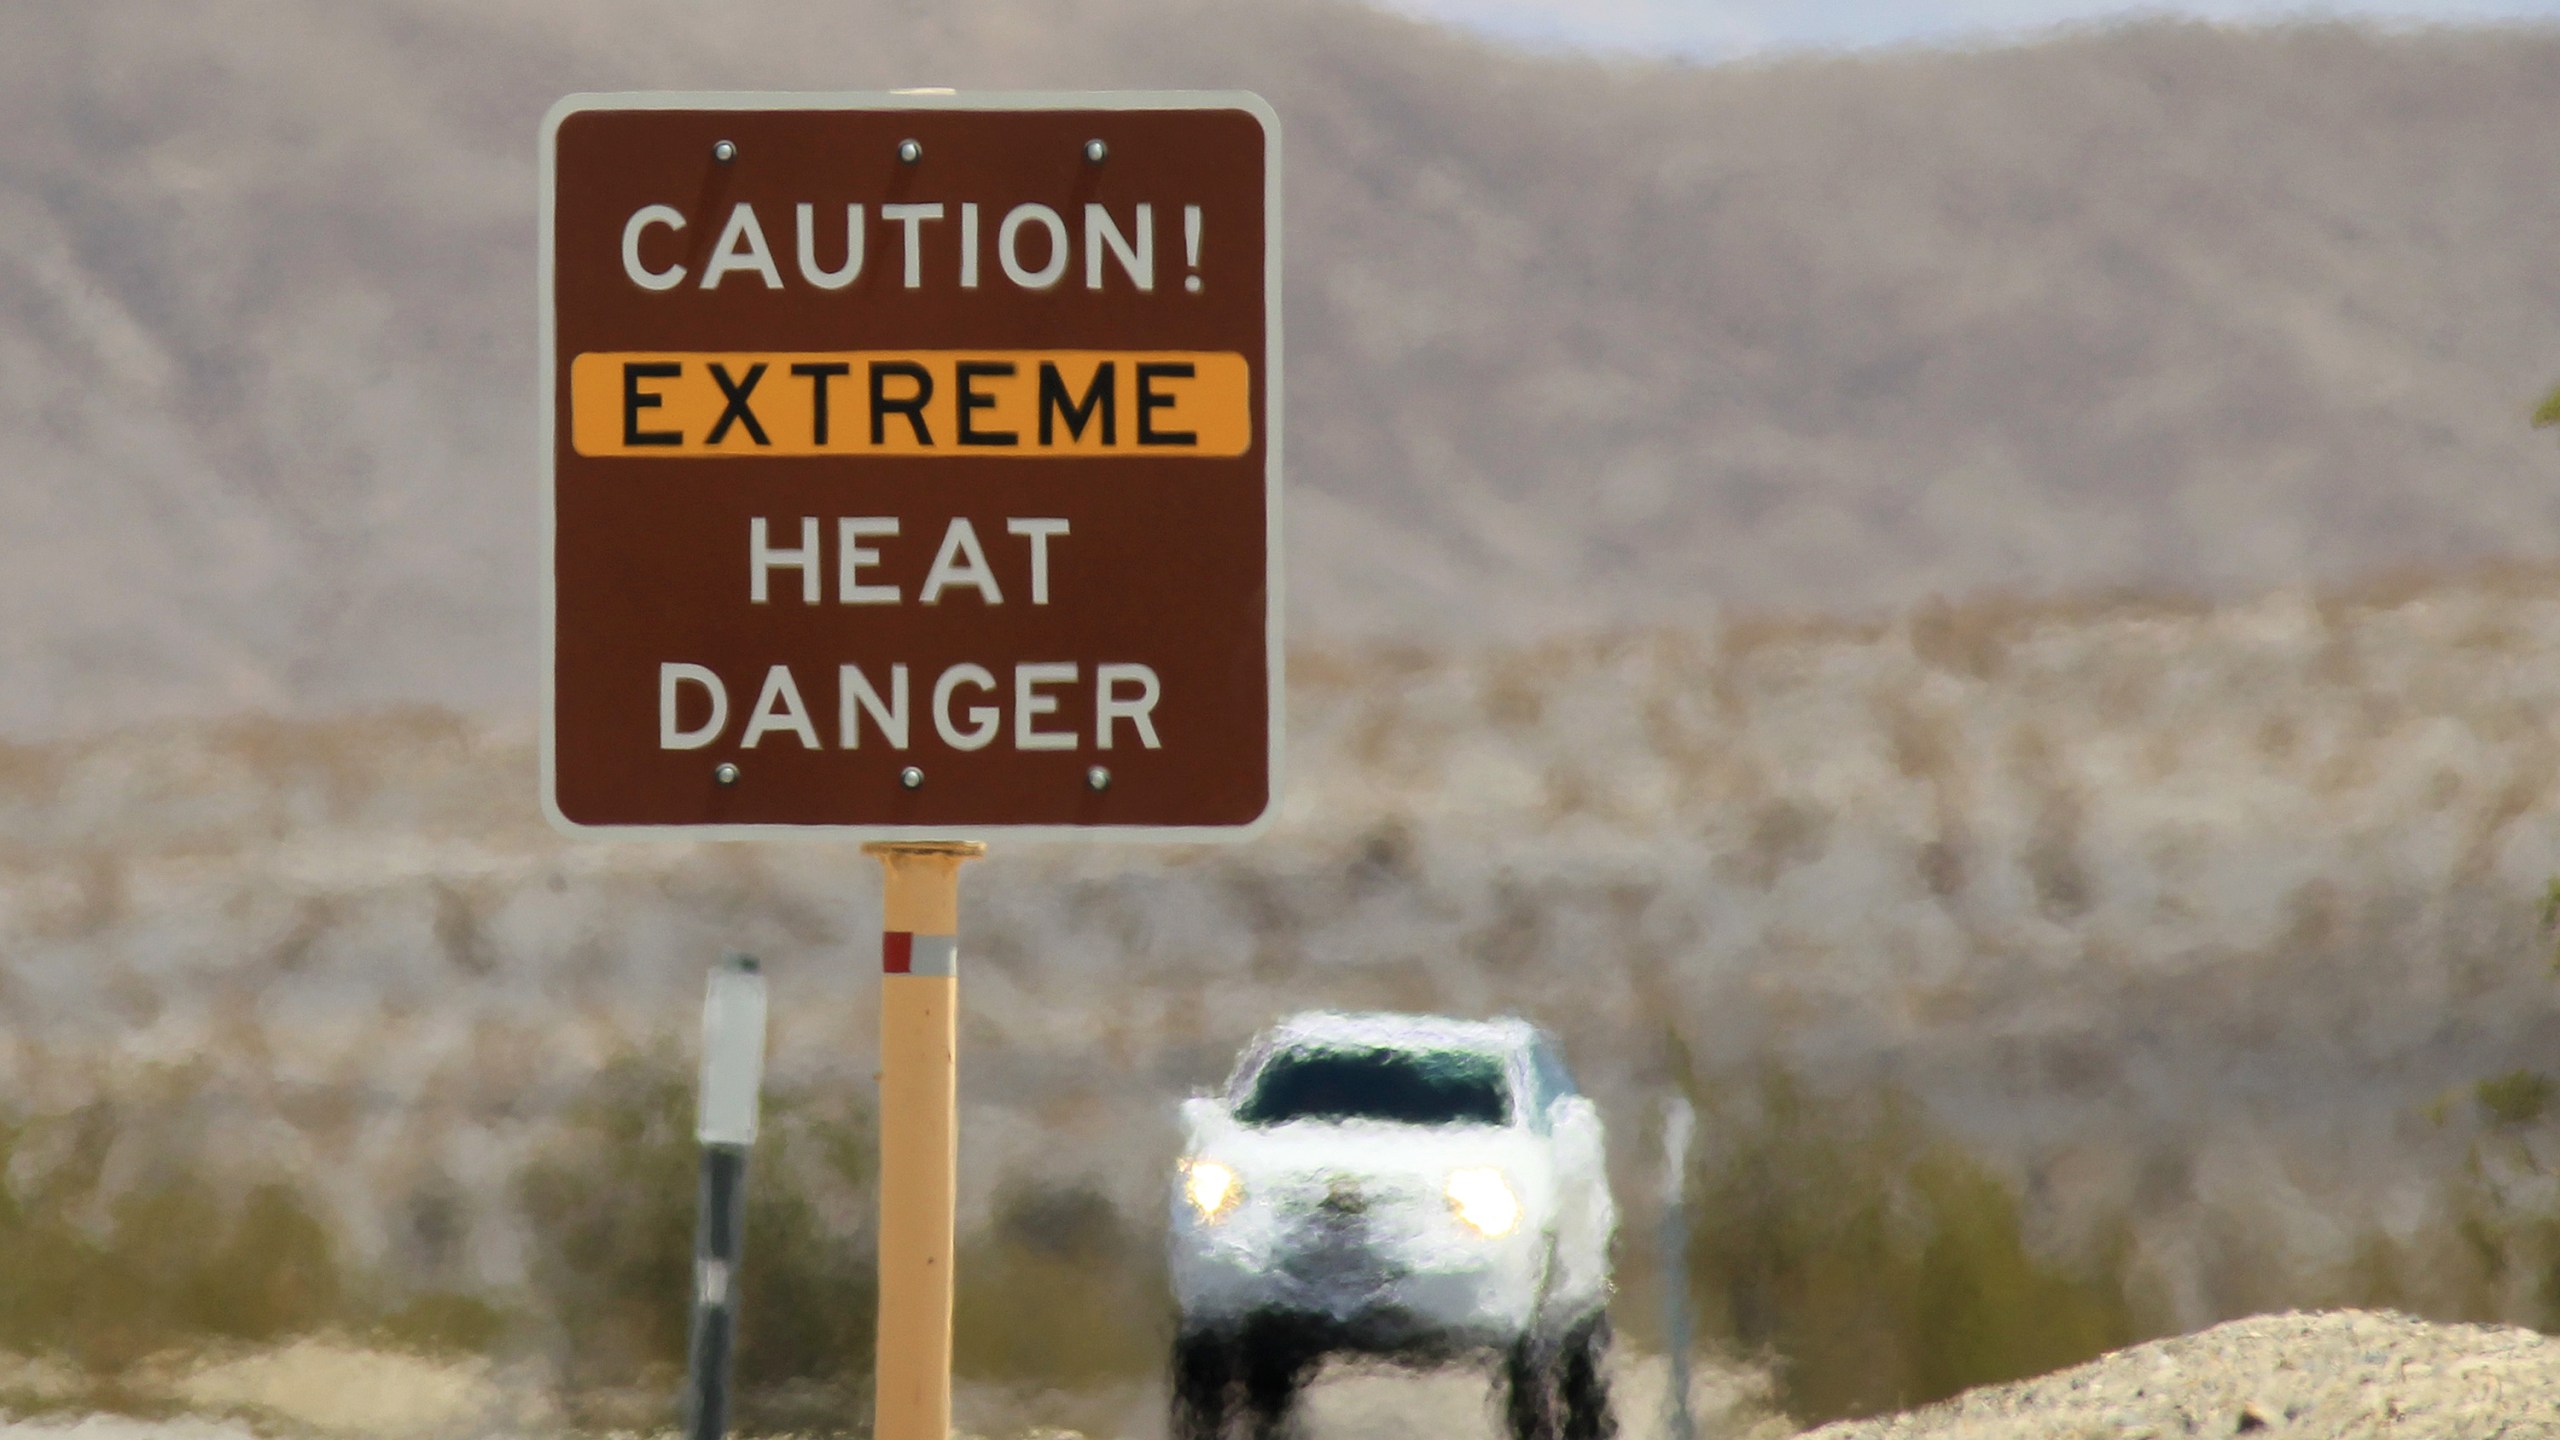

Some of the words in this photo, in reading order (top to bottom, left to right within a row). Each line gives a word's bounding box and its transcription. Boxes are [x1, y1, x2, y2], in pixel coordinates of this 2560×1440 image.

[622, 203, 1202, 292] CAUTION!
[622, 360, 1198, 448] EXTREME
[749, 516, 1070, 604] HEAT
[660, 662, 1161, 750] DANGER
